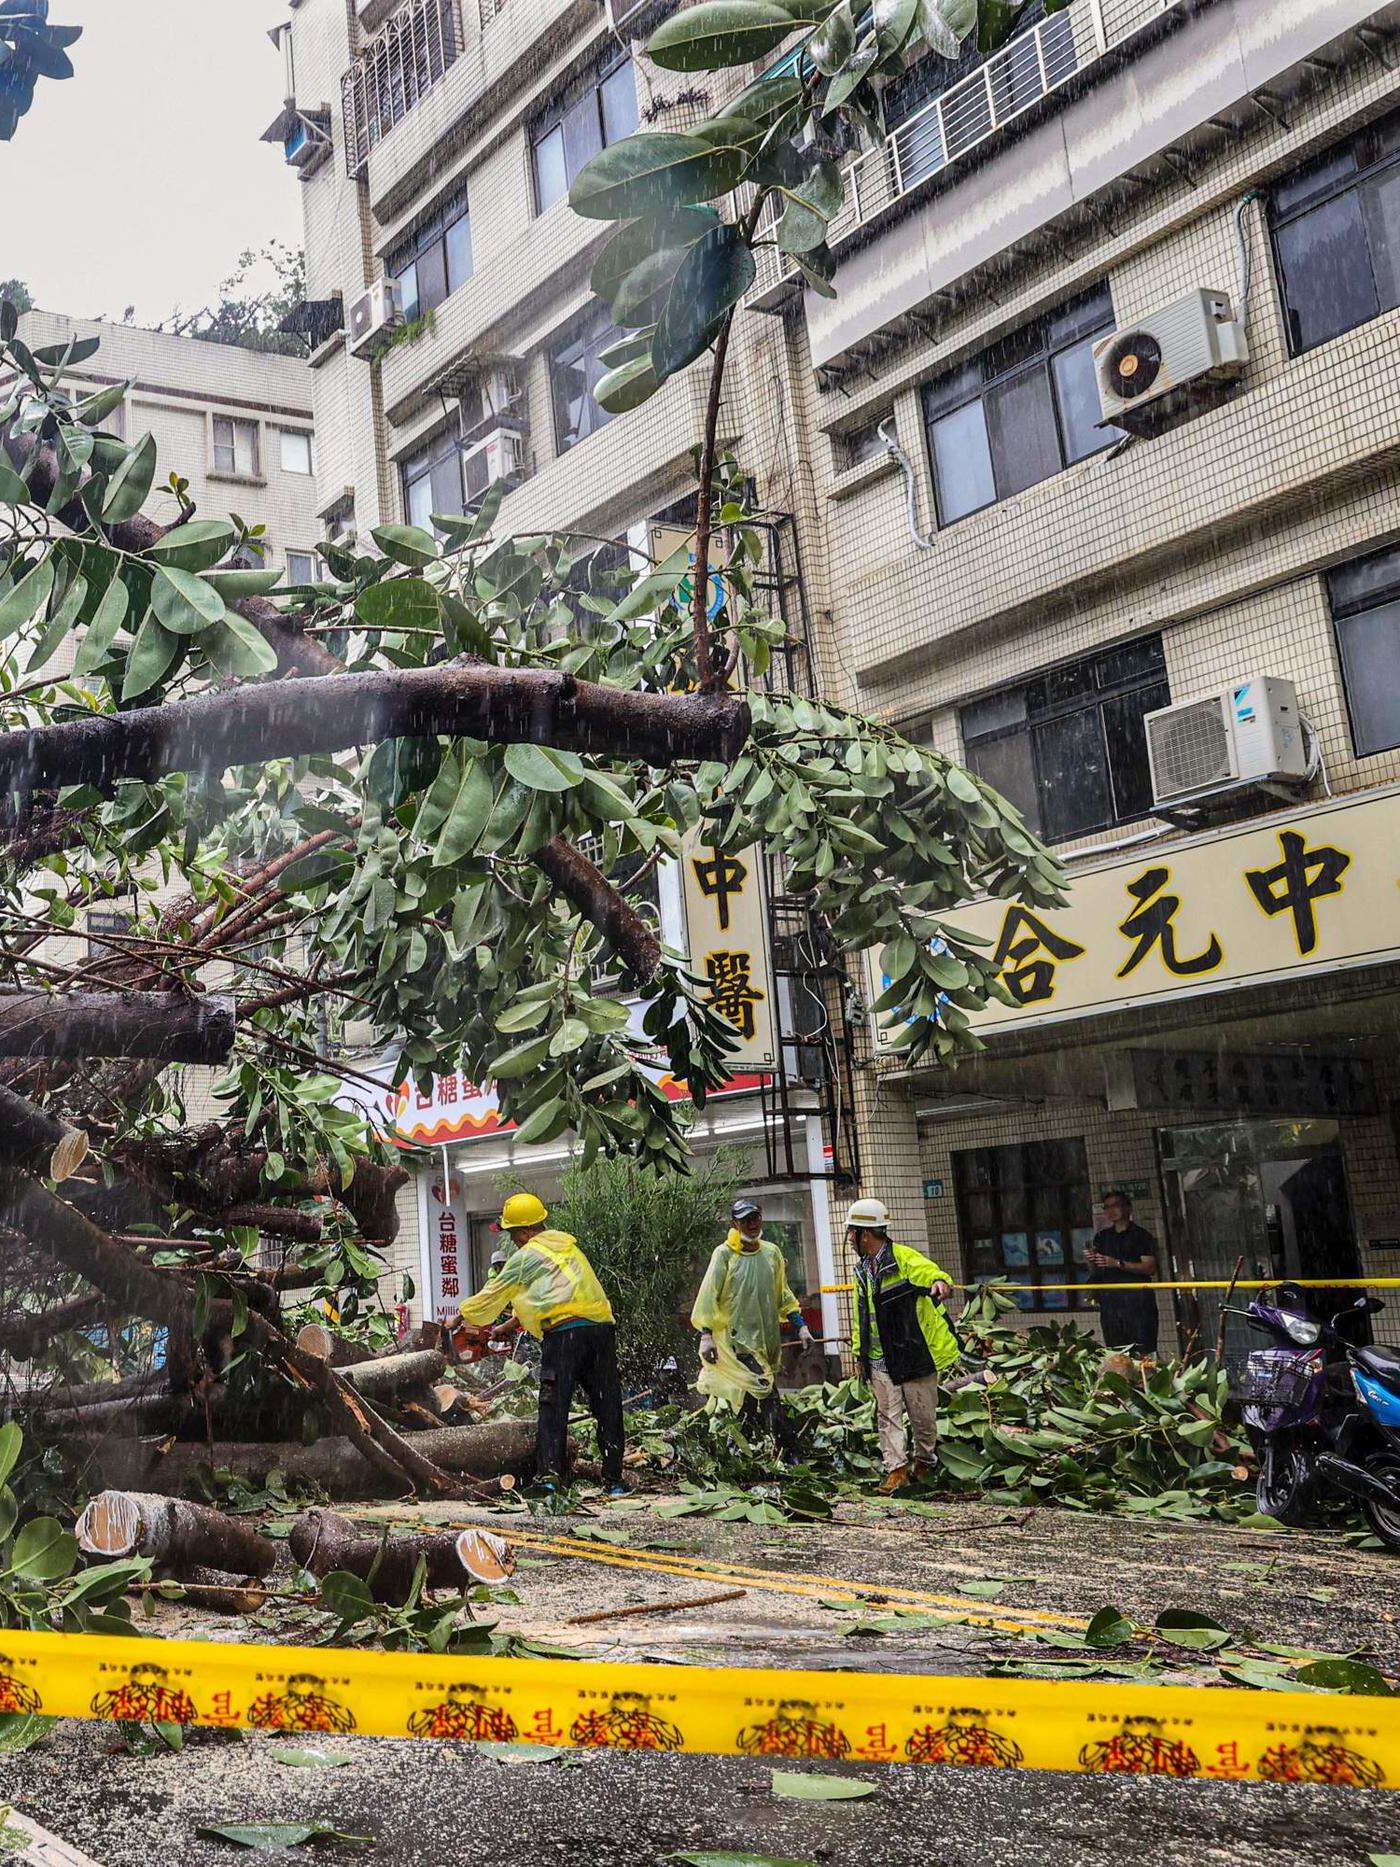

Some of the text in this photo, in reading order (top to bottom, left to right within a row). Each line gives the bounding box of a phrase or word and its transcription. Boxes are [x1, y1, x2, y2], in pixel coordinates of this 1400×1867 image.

[691, 846, 766, 1040] 中醫
[438, 1211, 460, 1298] 台糖蜜鄰
